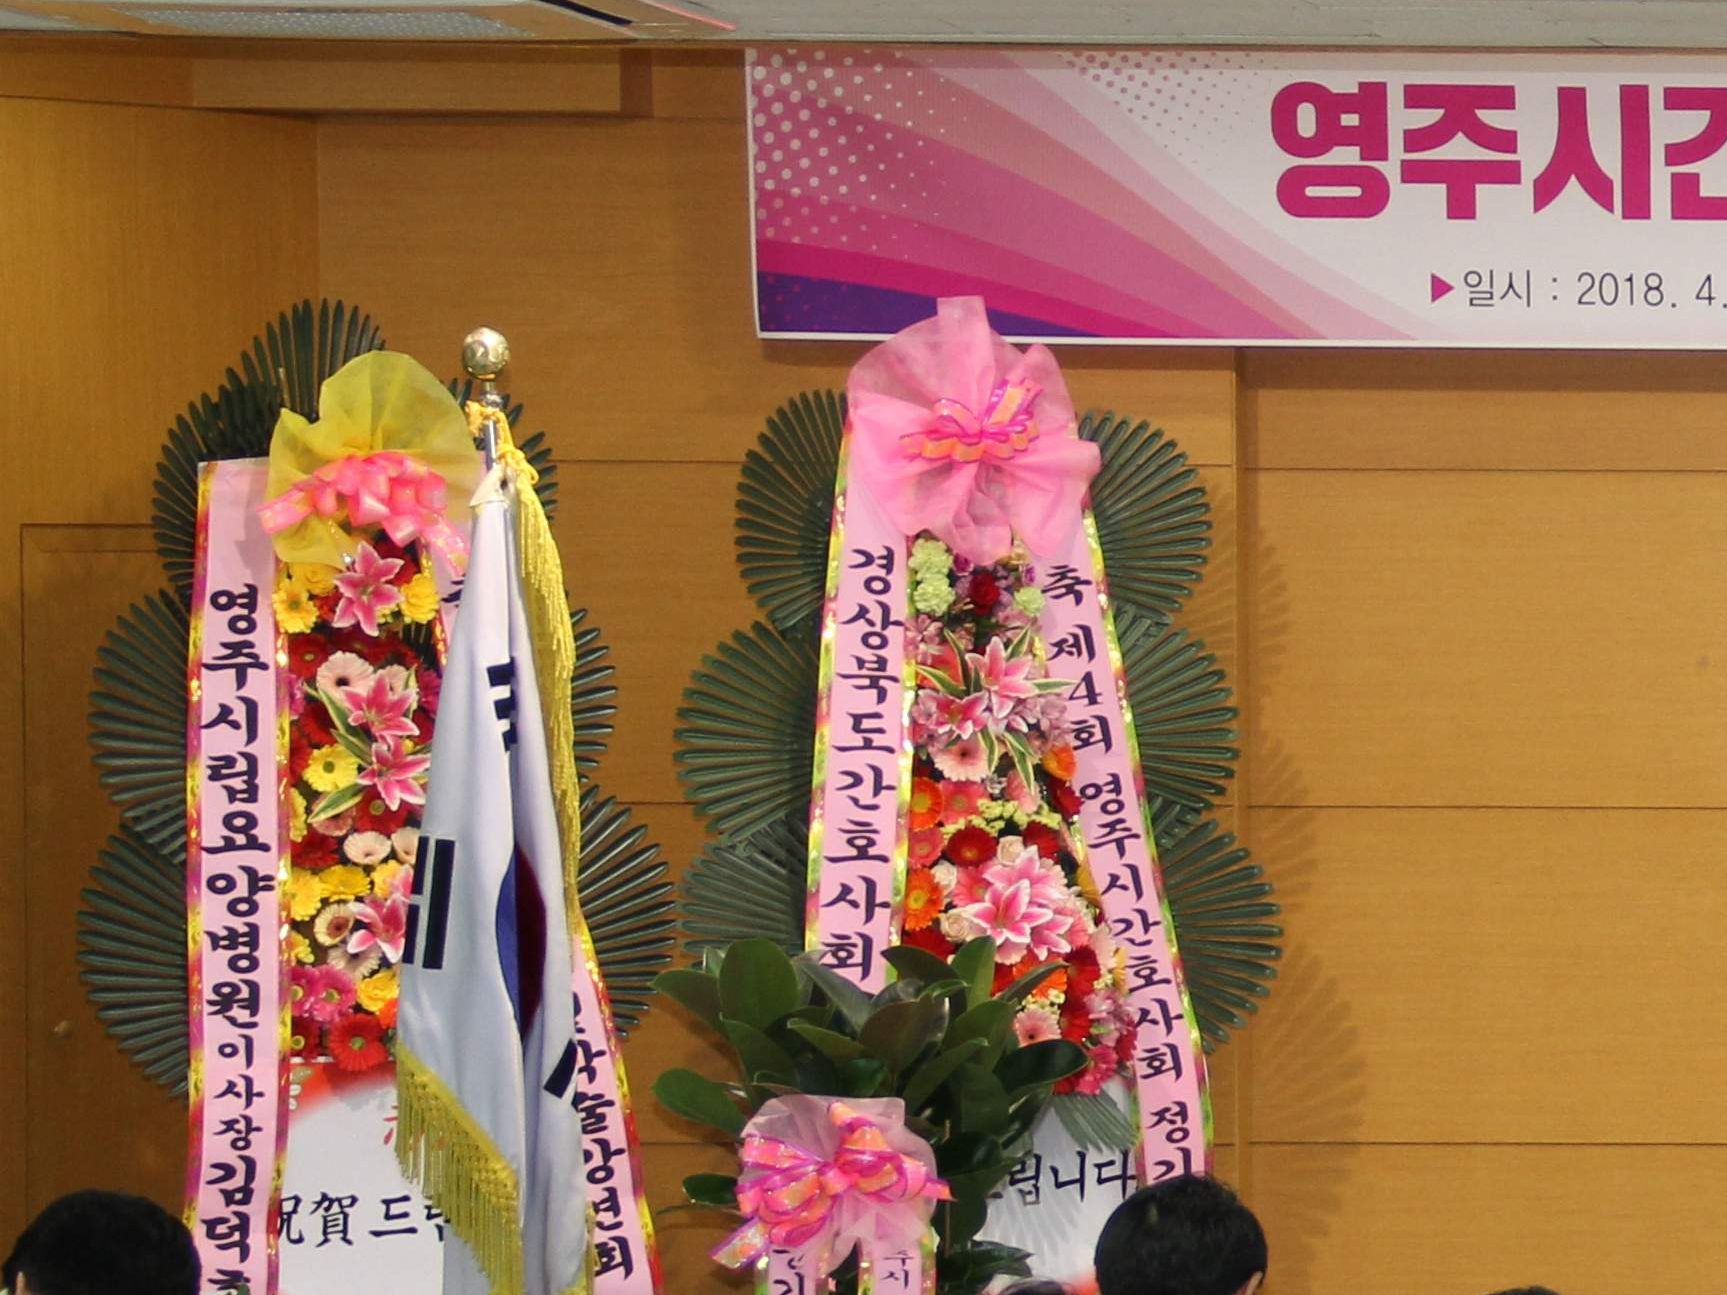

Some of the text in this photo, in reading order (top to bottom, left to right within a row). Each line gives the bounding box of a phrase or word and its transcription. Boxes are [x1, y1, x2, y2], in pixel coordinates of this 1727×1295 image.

[1462, 269, 1533, 309] 일시
[1576, 272, 1678, 309] 2018.
[200, 582, 277, 1030] 영주시립요양병원
[817, 545, 905, 983] 경상북도간호사회
[1041, 564, 1193, 1182] 축 제4회 영주시간호사회 정기
[213, 1033, 266, 1152] 이사장
[990, 1150, 1138, 1205] 립니다
